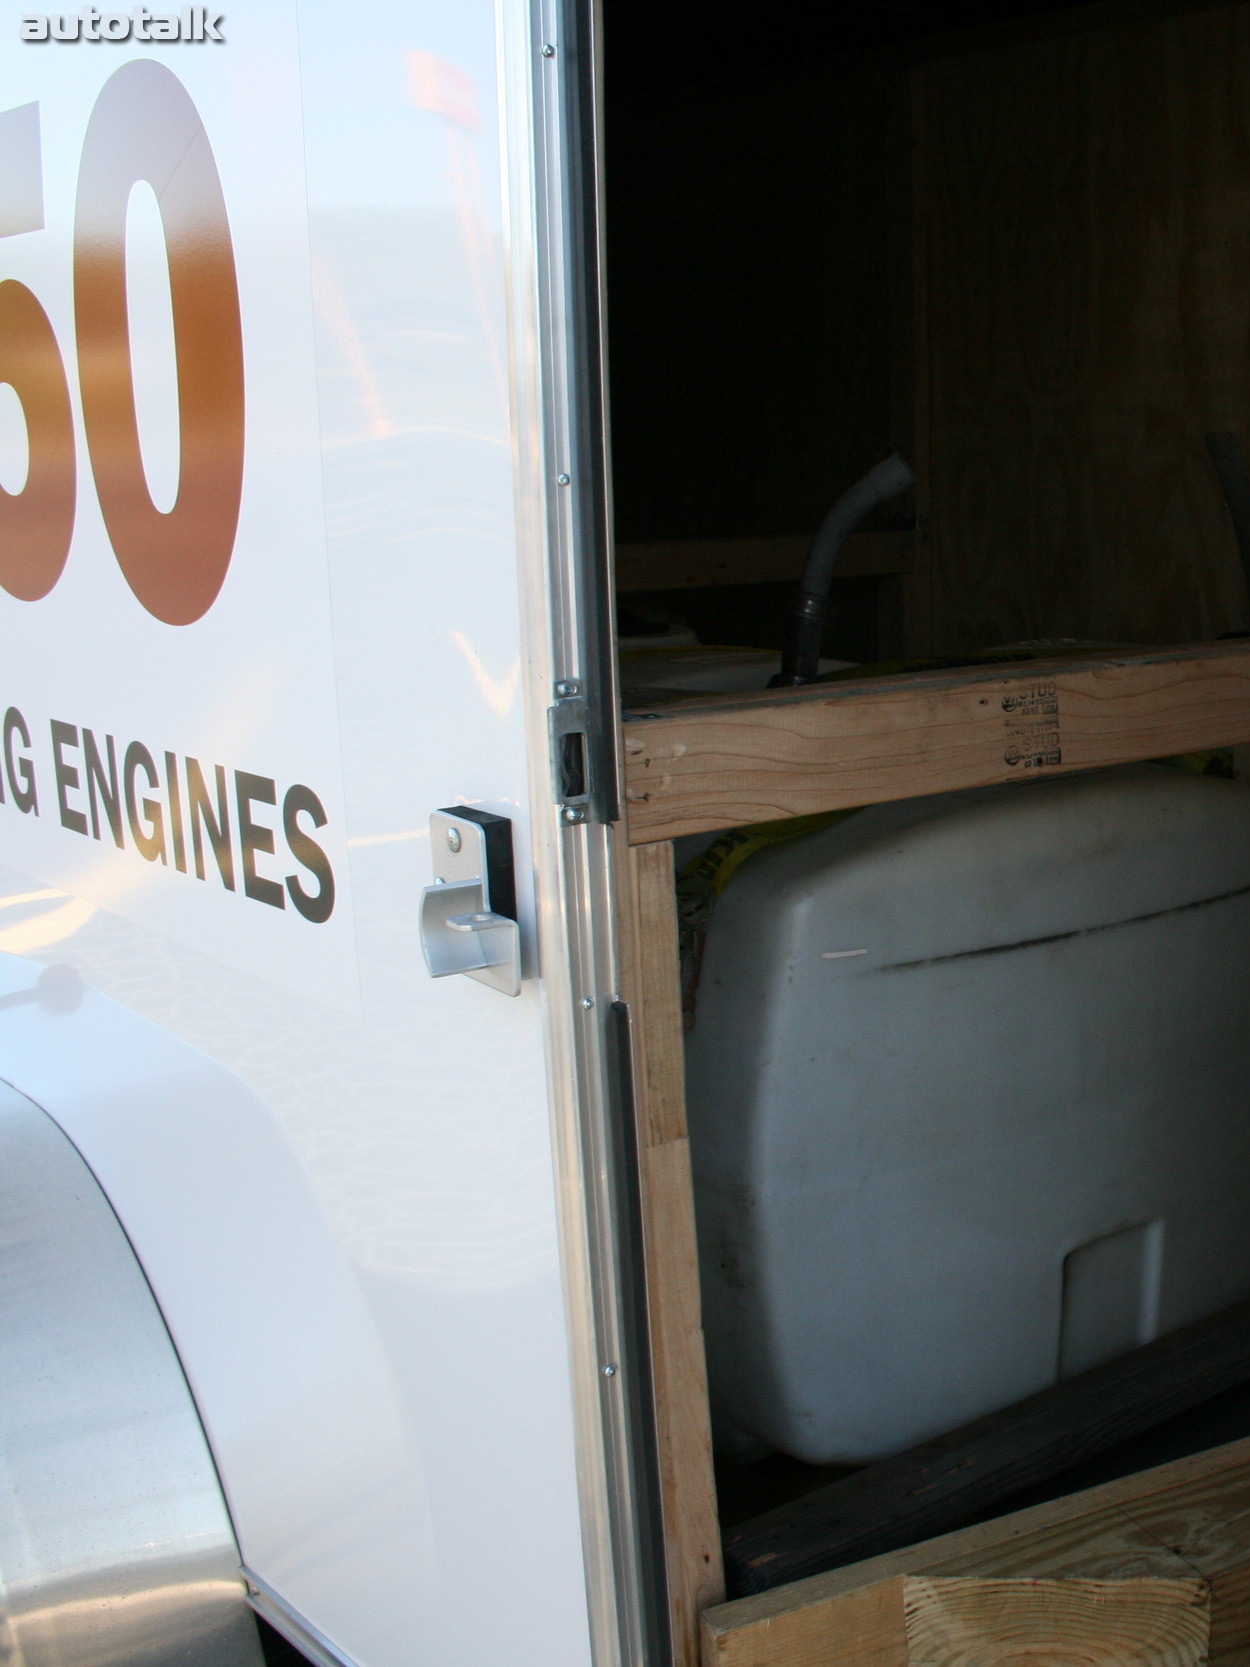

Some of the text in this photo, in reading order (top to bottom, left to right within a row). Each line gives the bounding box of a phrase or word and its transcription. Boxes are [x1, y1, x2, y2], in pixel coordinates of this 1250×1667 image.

[1019, 681, 1057, 699] STUD
[1023, 732, 1060, 751] STUD
[0, 706, 335, 924] G ENGINES
